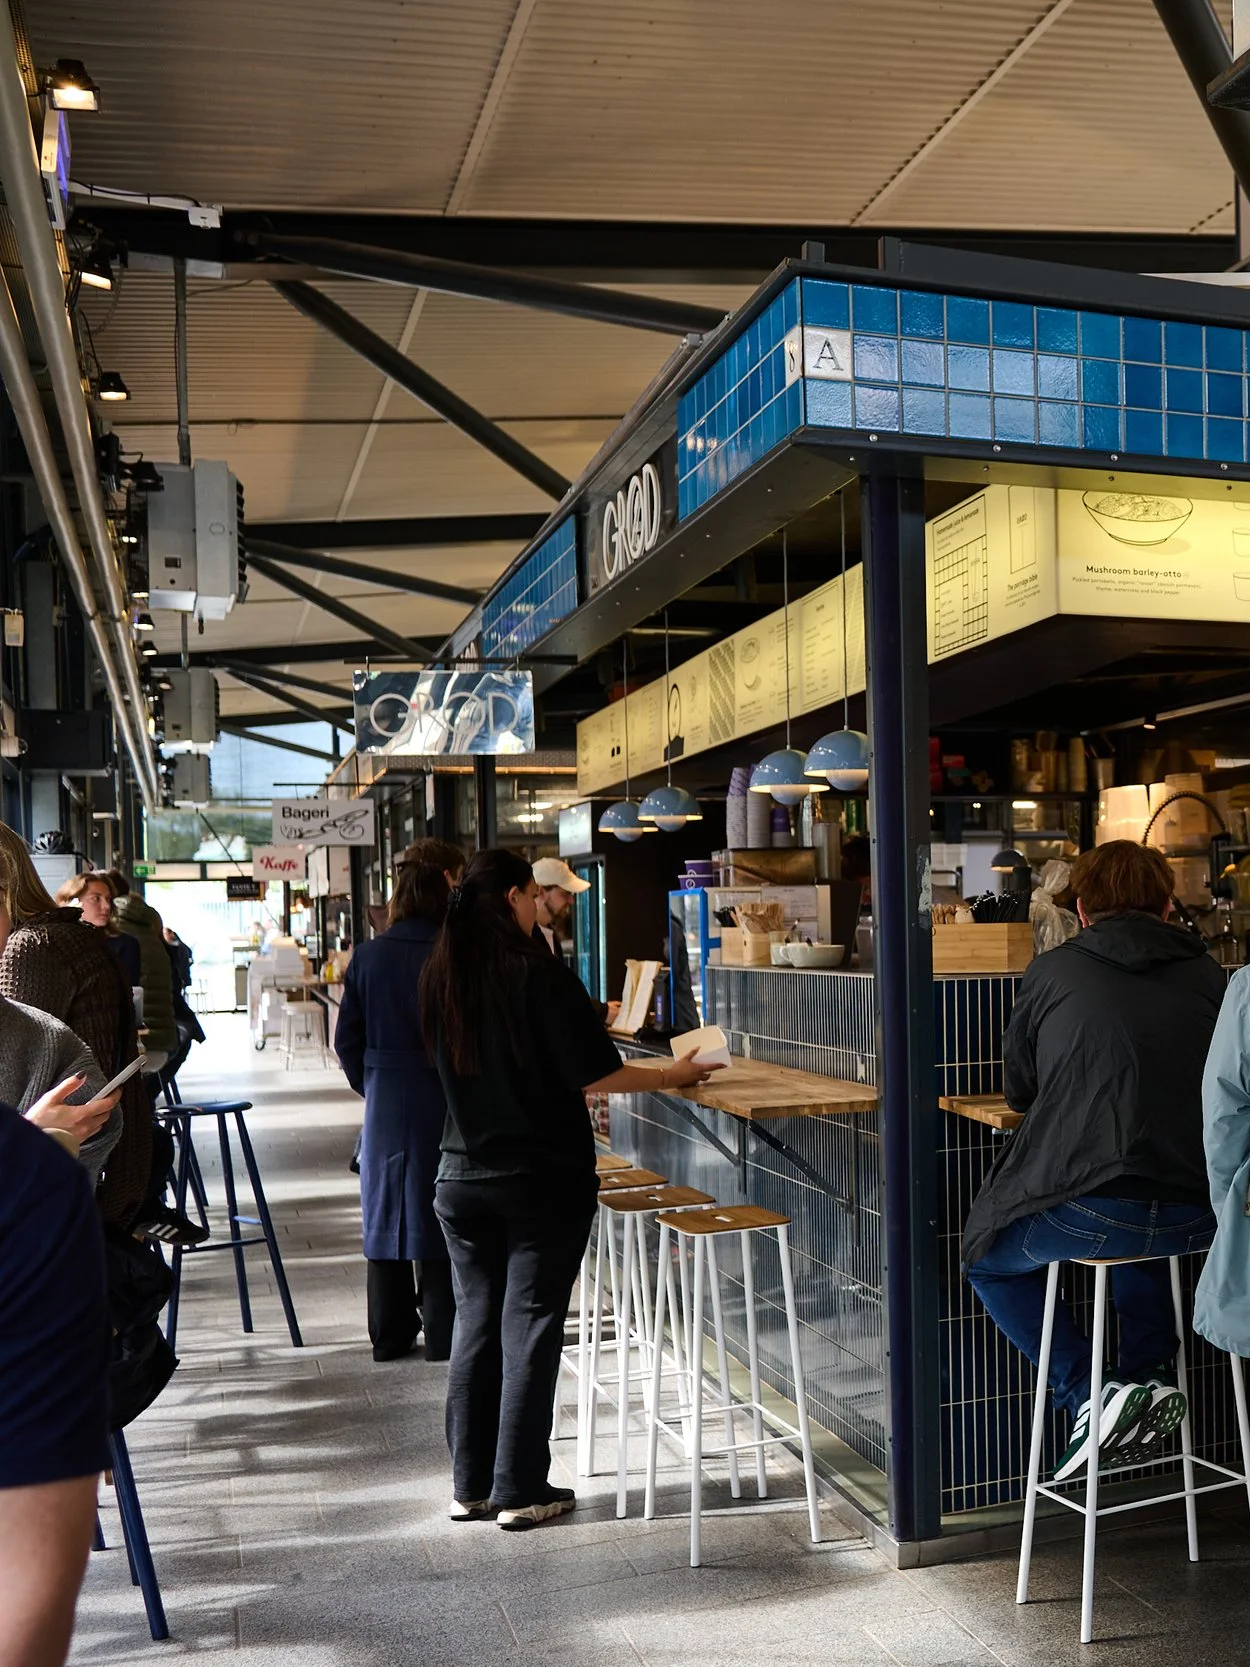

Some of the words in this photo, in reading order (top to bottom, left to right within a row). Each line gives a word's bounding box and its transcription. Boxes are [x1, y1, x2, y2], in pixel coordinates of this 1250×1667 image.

[812, 337, 844, 371] A
[1086, 565, 1131, 575] Mushroom
[1133, 568, 1182, 579] barley-otto
[281, 805, 329, 822] Bageri
